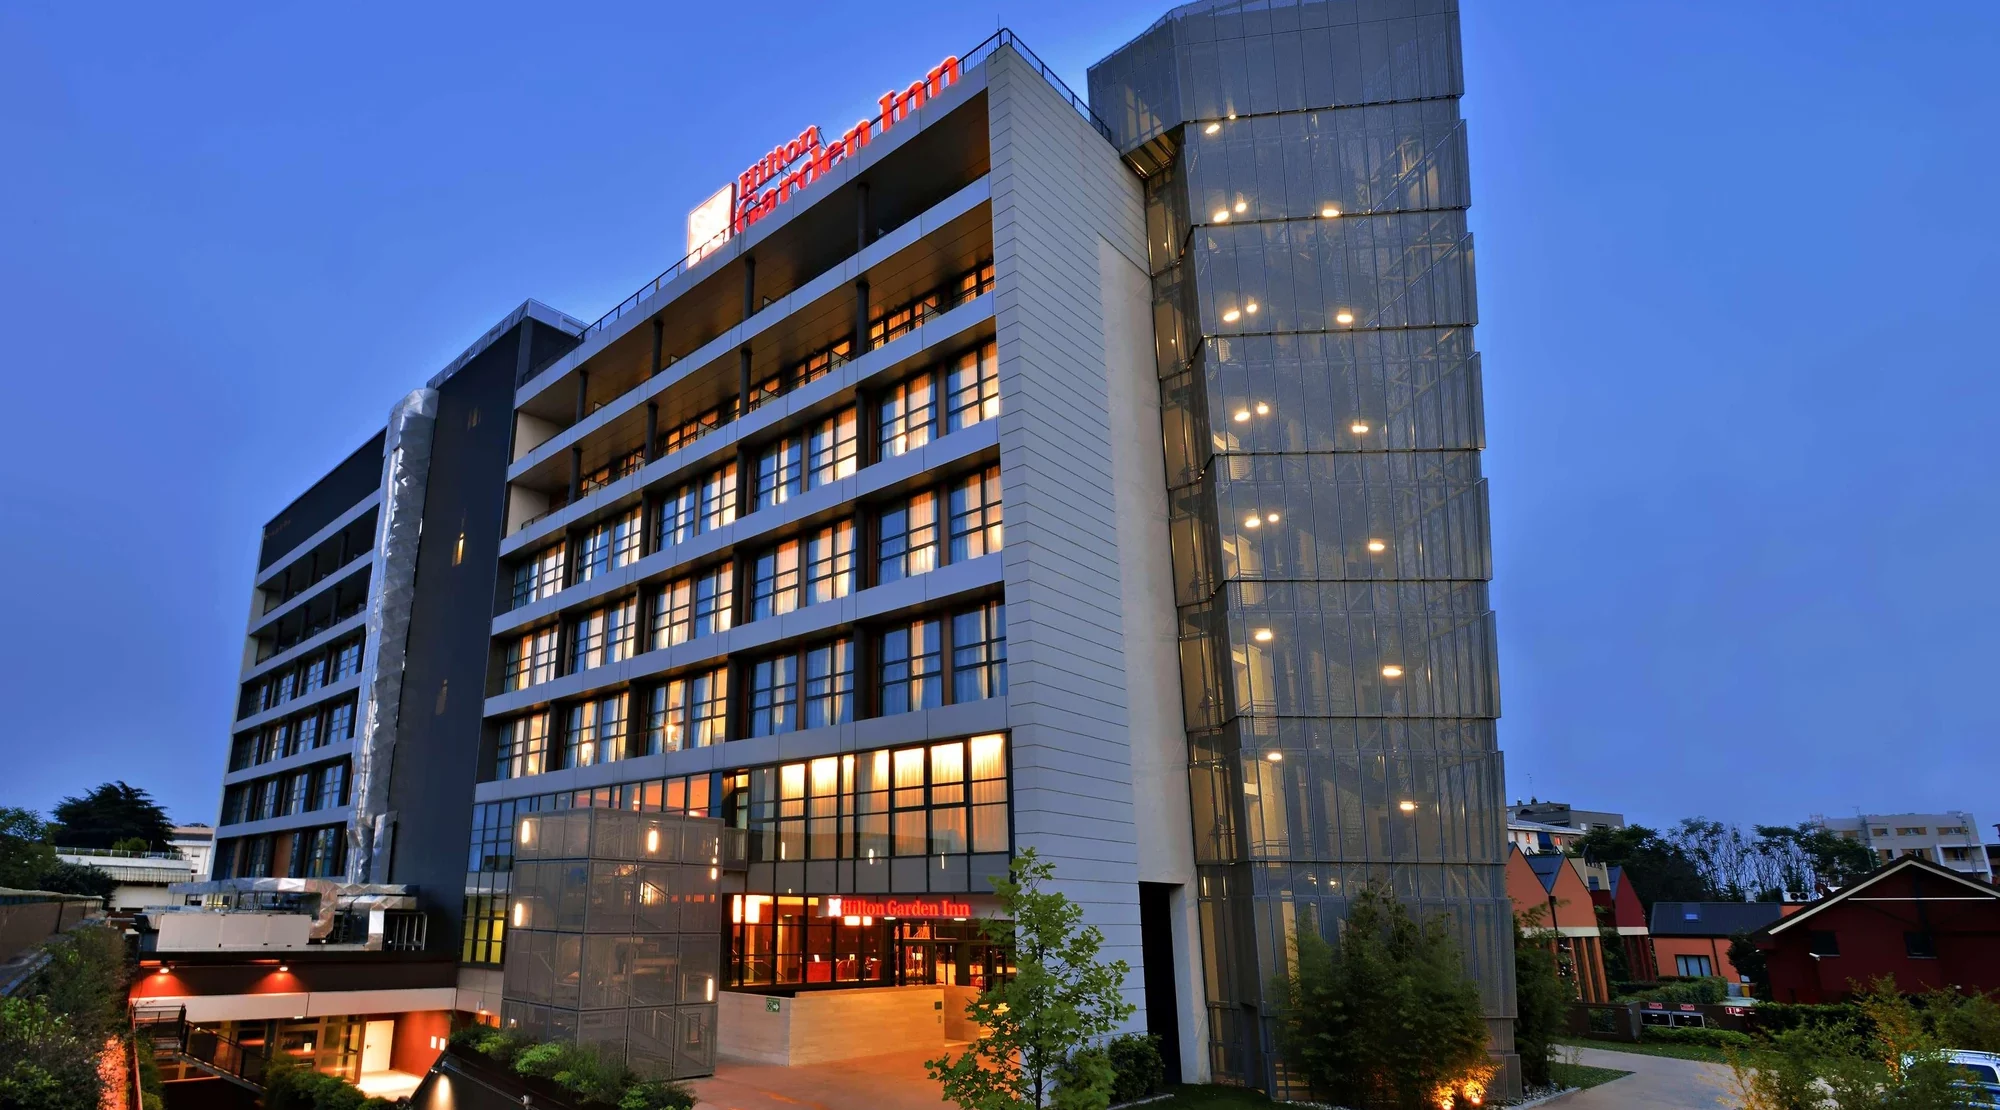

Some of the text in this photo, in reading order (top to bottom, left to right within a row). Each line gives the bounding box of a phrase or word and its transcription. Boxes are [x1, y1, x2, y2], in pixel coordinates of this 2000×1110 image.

[735, 55, 958, 233] Garden Inn
[738, 125, 818, 200] Hilton
[842, 901, 970, 917] Hilton Garden Inn
